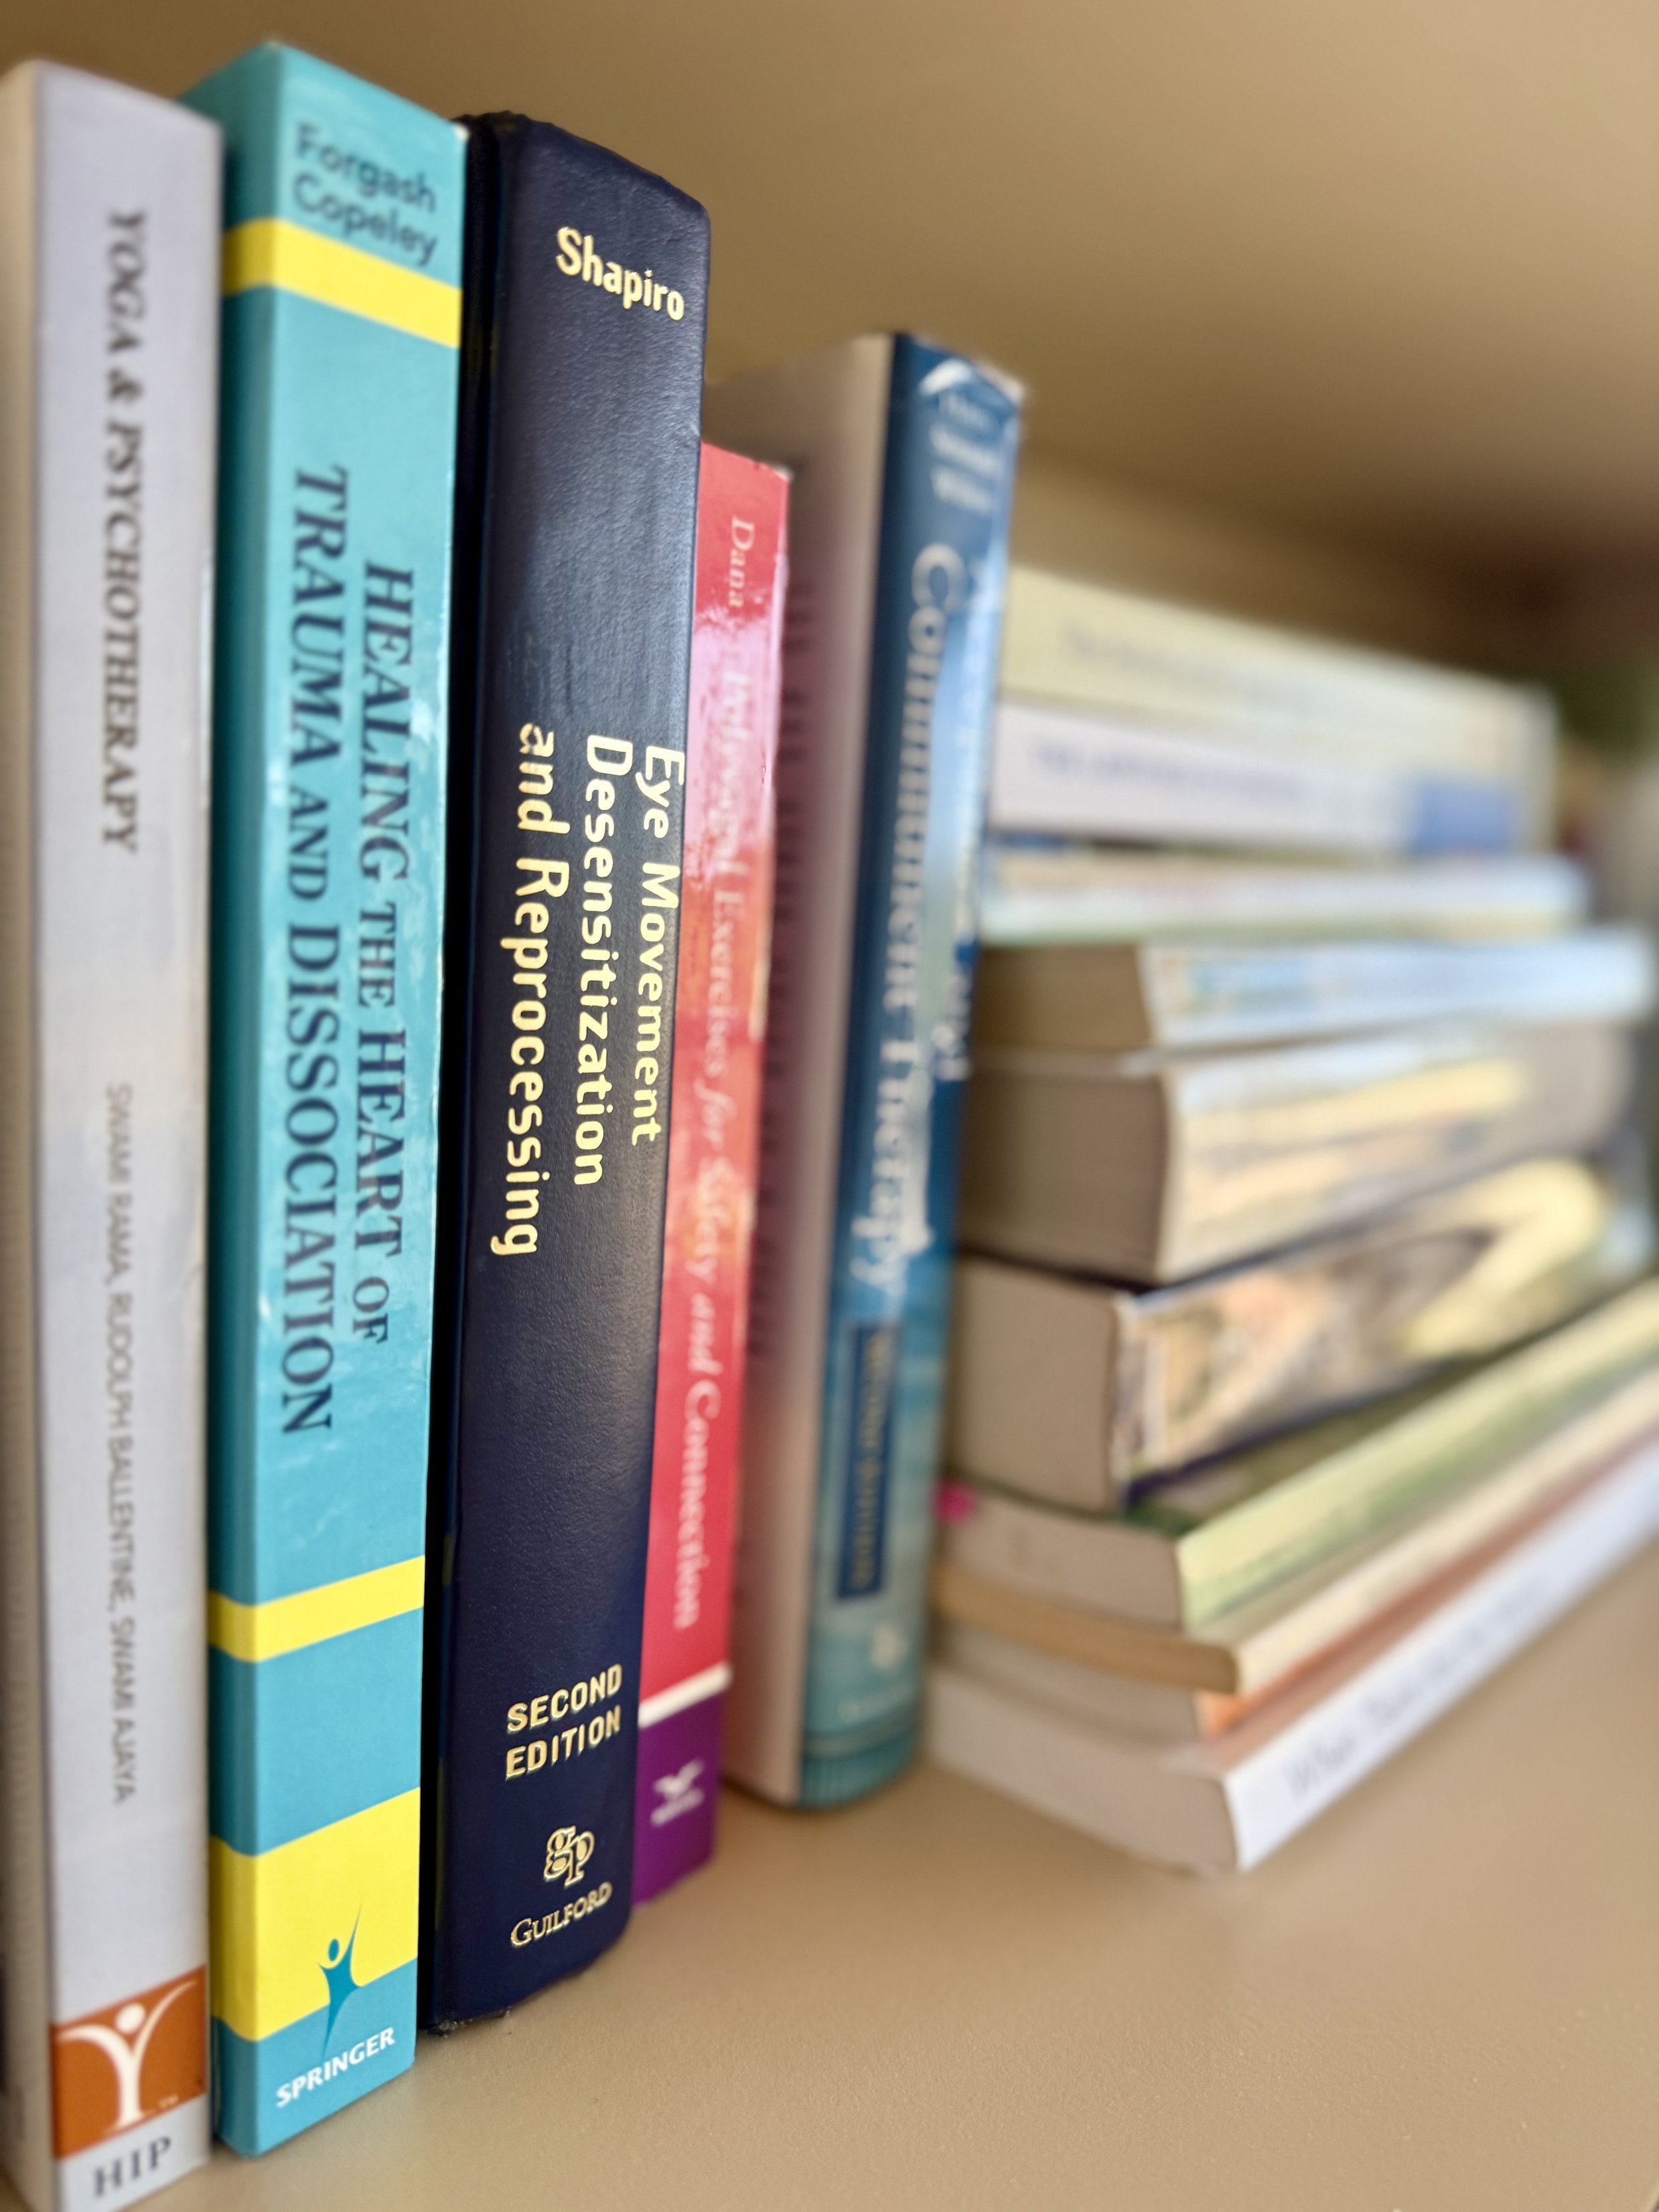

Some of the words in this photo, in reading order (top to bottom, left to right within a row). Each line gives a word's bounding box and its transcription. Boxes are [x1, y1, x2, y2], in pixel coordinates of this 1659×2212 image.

[296, 122, 436, 214] Forgash
[293, 171, 437, 267] Copeley
[107, 210, 147, 355] YOGA
[556, 226, 684, 321] Shapiro
[107, 369, 144, 402] &
[727, 516, 755, 609] Dana
[102, 421, 144, 853] PSYCHOTHERAPY
[289, 464, 348, 768] TRAUMA
[359, 561, 414, 883] HEALING
[516, 723, 571, 834] and
[635, 746, 685, 840] Eye
[287, 786, 330, 902] AND
[358, 903, 396, 1009] THE
[573, 734, 633, 1186] Desensitization
[631, 862, 681, 1147] Movement
[702, 889, 749, 1079] Exercises
[490, 857, 570, 1256] Reprocessing
[105, 1083, 134, 1183] SWAMI
[354, 1027, 407, 1256] HEART
[693, 1079, 739, 1150] for
[282, 924, 340, 1435] DISSOCIATION
[352, 1276, 390, 1345] OF
[686, 1291, 726, 1376] and
[106, 1293, 134, 1428] RUDOLPH
[672, 1379, 725, 1631] Connection
[111, 1618, 137, 1711] SWAMI
[507, 1662, 622, 1733] SECOND
[111, 1719, 138, 1805] AJAYA
[505, 1704, 621, 1780] EDITION
[543, 1826, 595, 1887] gp
[276, 2027, 396, 2108] SPRINGER
[94, 2134, 171, 2198] HIP
